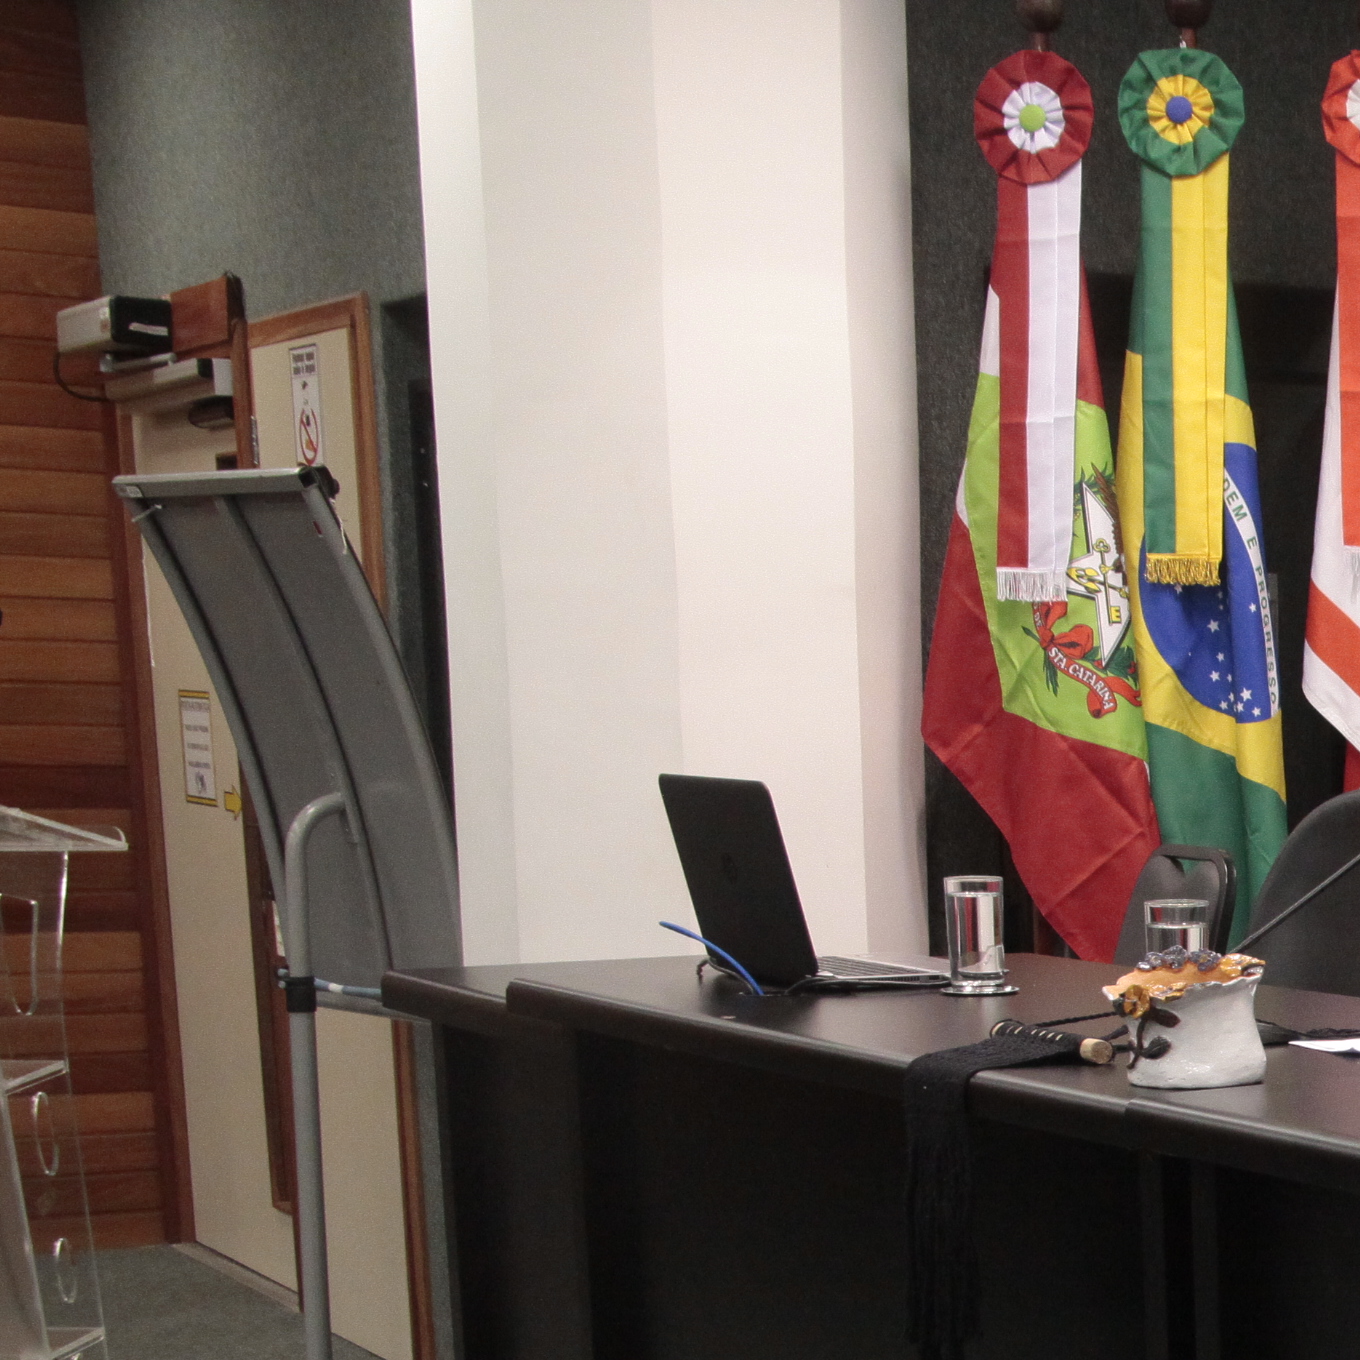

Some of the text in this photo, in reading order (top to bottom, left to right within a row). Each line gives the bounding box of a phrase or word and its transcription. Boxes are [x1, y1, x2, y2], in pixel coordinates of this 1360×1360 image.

[1223, 478, 1248, 522] DEM
[1247, 535, 1258, 550] E
[1048, 646, 1068, 670] STA.
[1068, 663, 1115, 710] CATARINA
